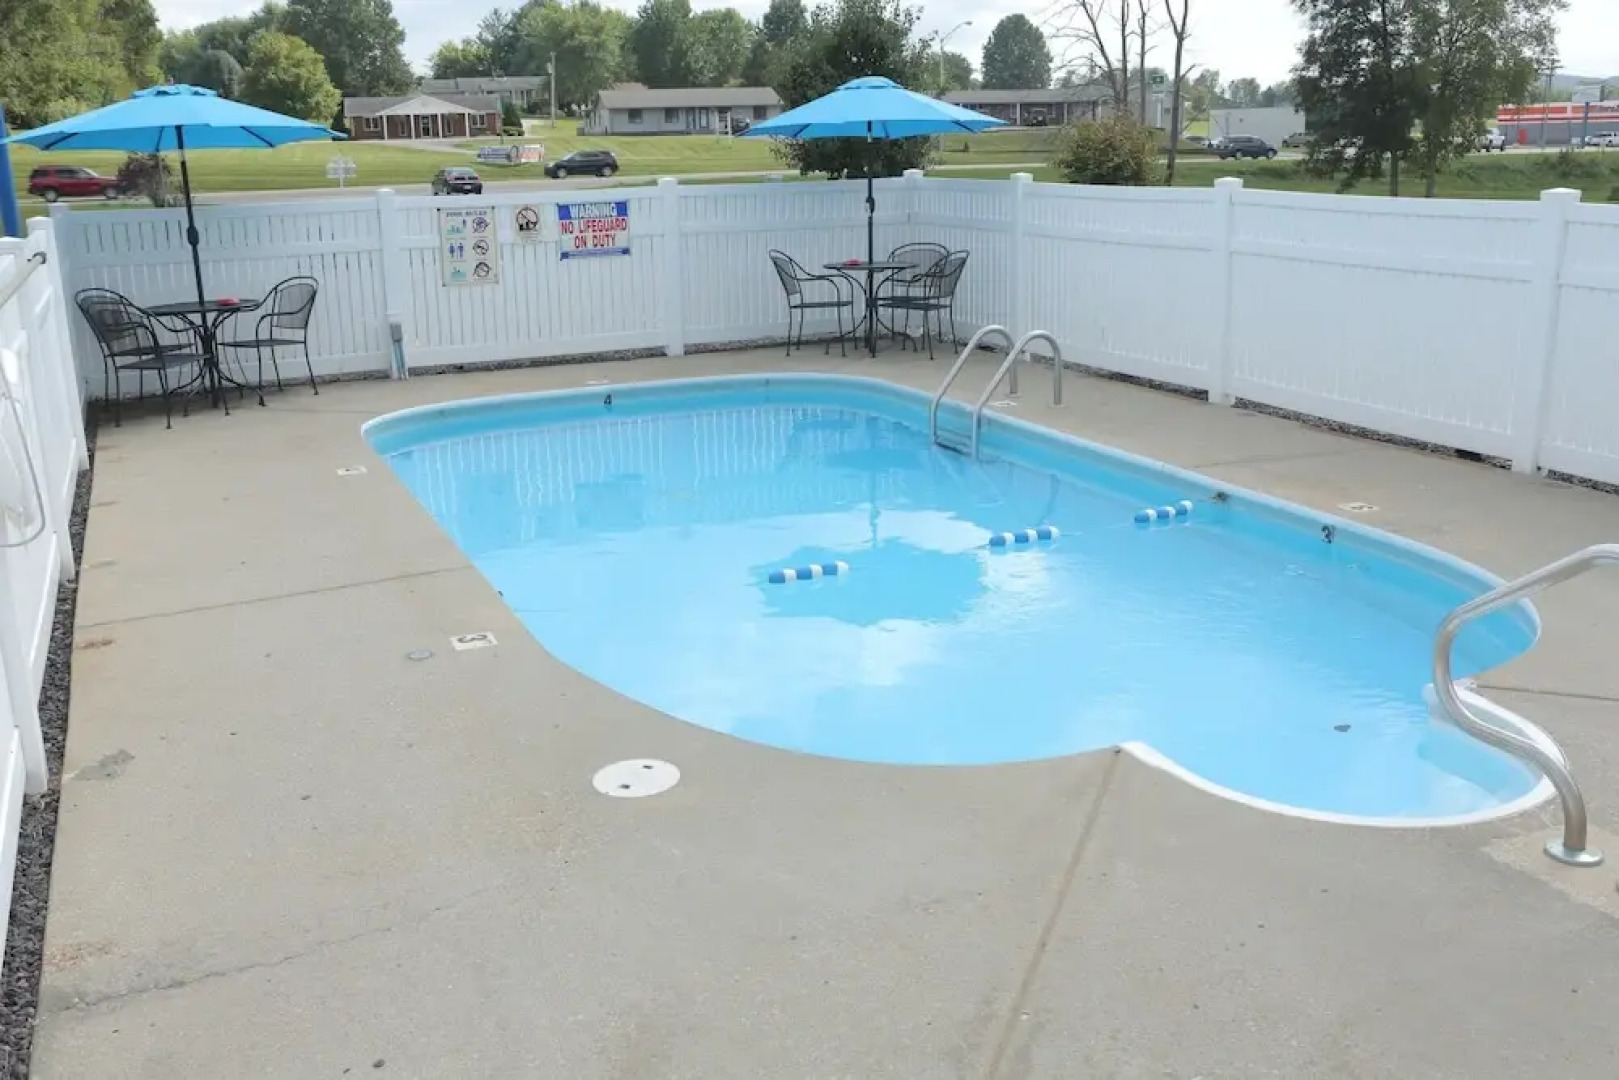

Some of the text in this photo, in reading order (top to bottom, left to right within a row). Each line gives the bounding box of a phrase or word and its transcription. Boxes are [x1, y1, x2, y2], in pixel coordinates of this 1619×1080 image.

[569, 203, 616, 218] WARNING
[561, 216, 627, 235] NO LIFEGUARD
[574, 232, 616, 248] ON DUTY
[603, 394, 612, 405] 4
